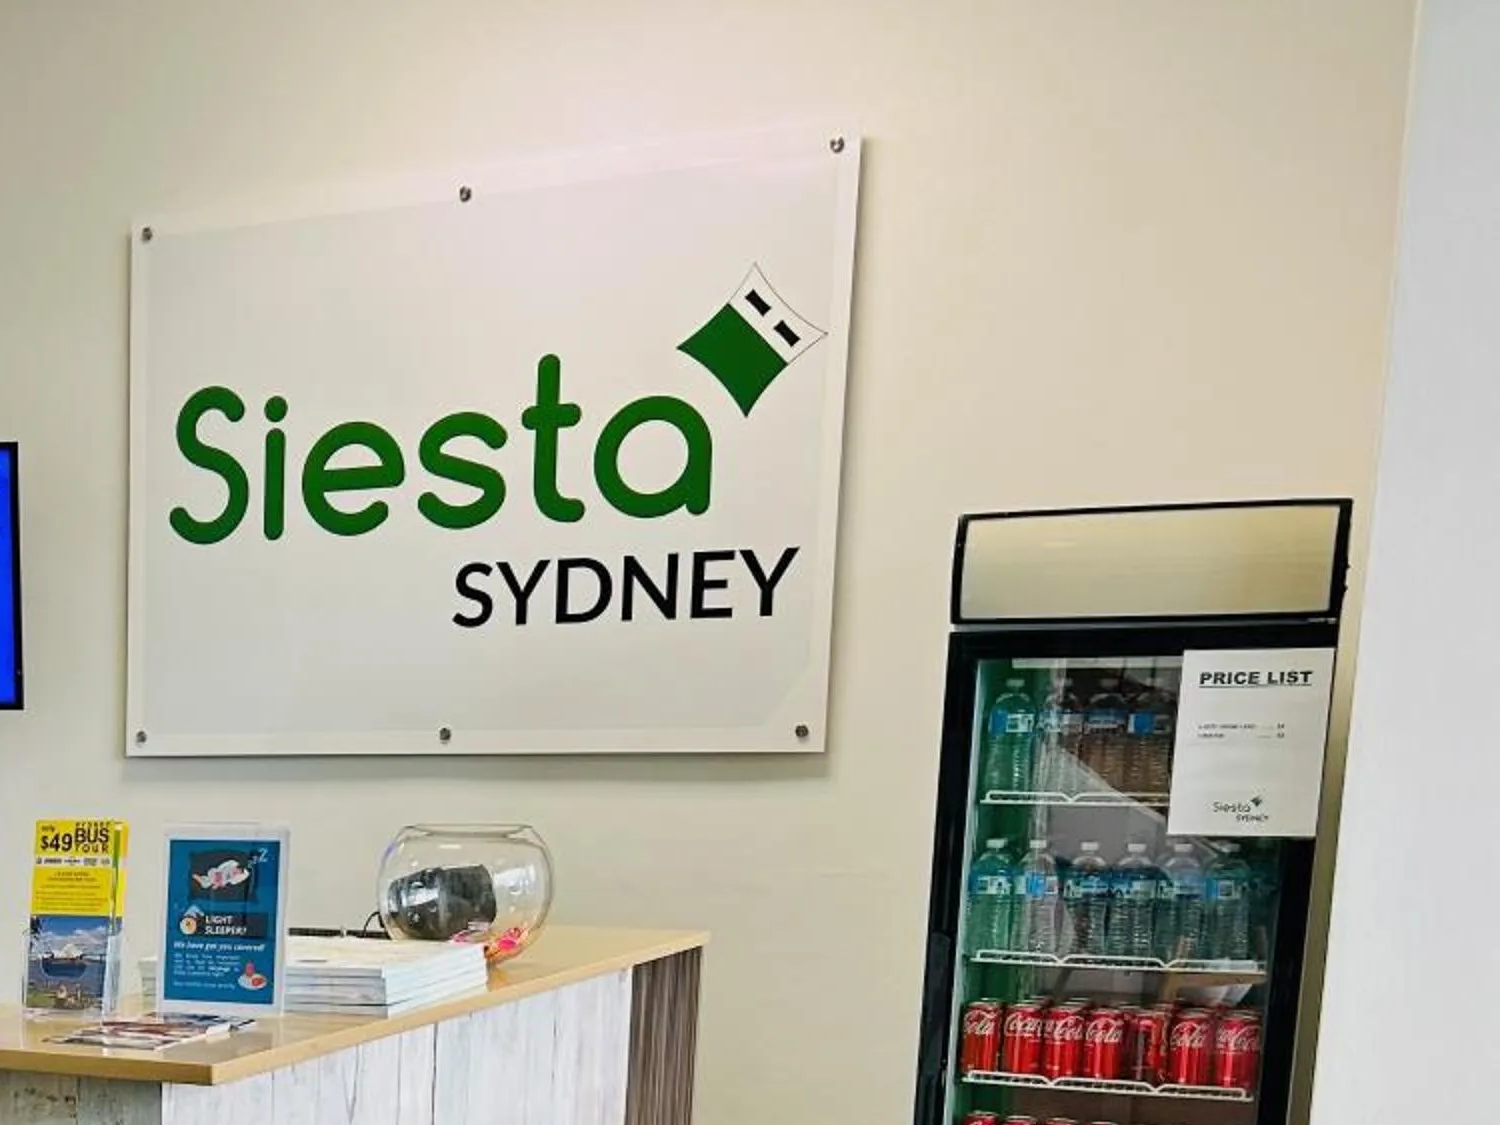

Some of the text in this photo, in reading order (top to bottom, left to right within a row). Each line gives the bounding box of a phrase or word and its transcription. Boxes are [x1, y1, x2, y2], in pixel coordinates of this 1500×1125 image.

[168, 353, 713, 544] Siesta
[452, 546, 800, 628] SYDNEY
[1199, 670, 1314, 685] PRICE LIST
[1213, 801, 1251, 813] Siesta
[40, 832, 73, 852] $49
[75, 827, 109, 844] BUS
[75, 843, 109, 853] TOUR
[205, 915, 233, 925] LIGHT
